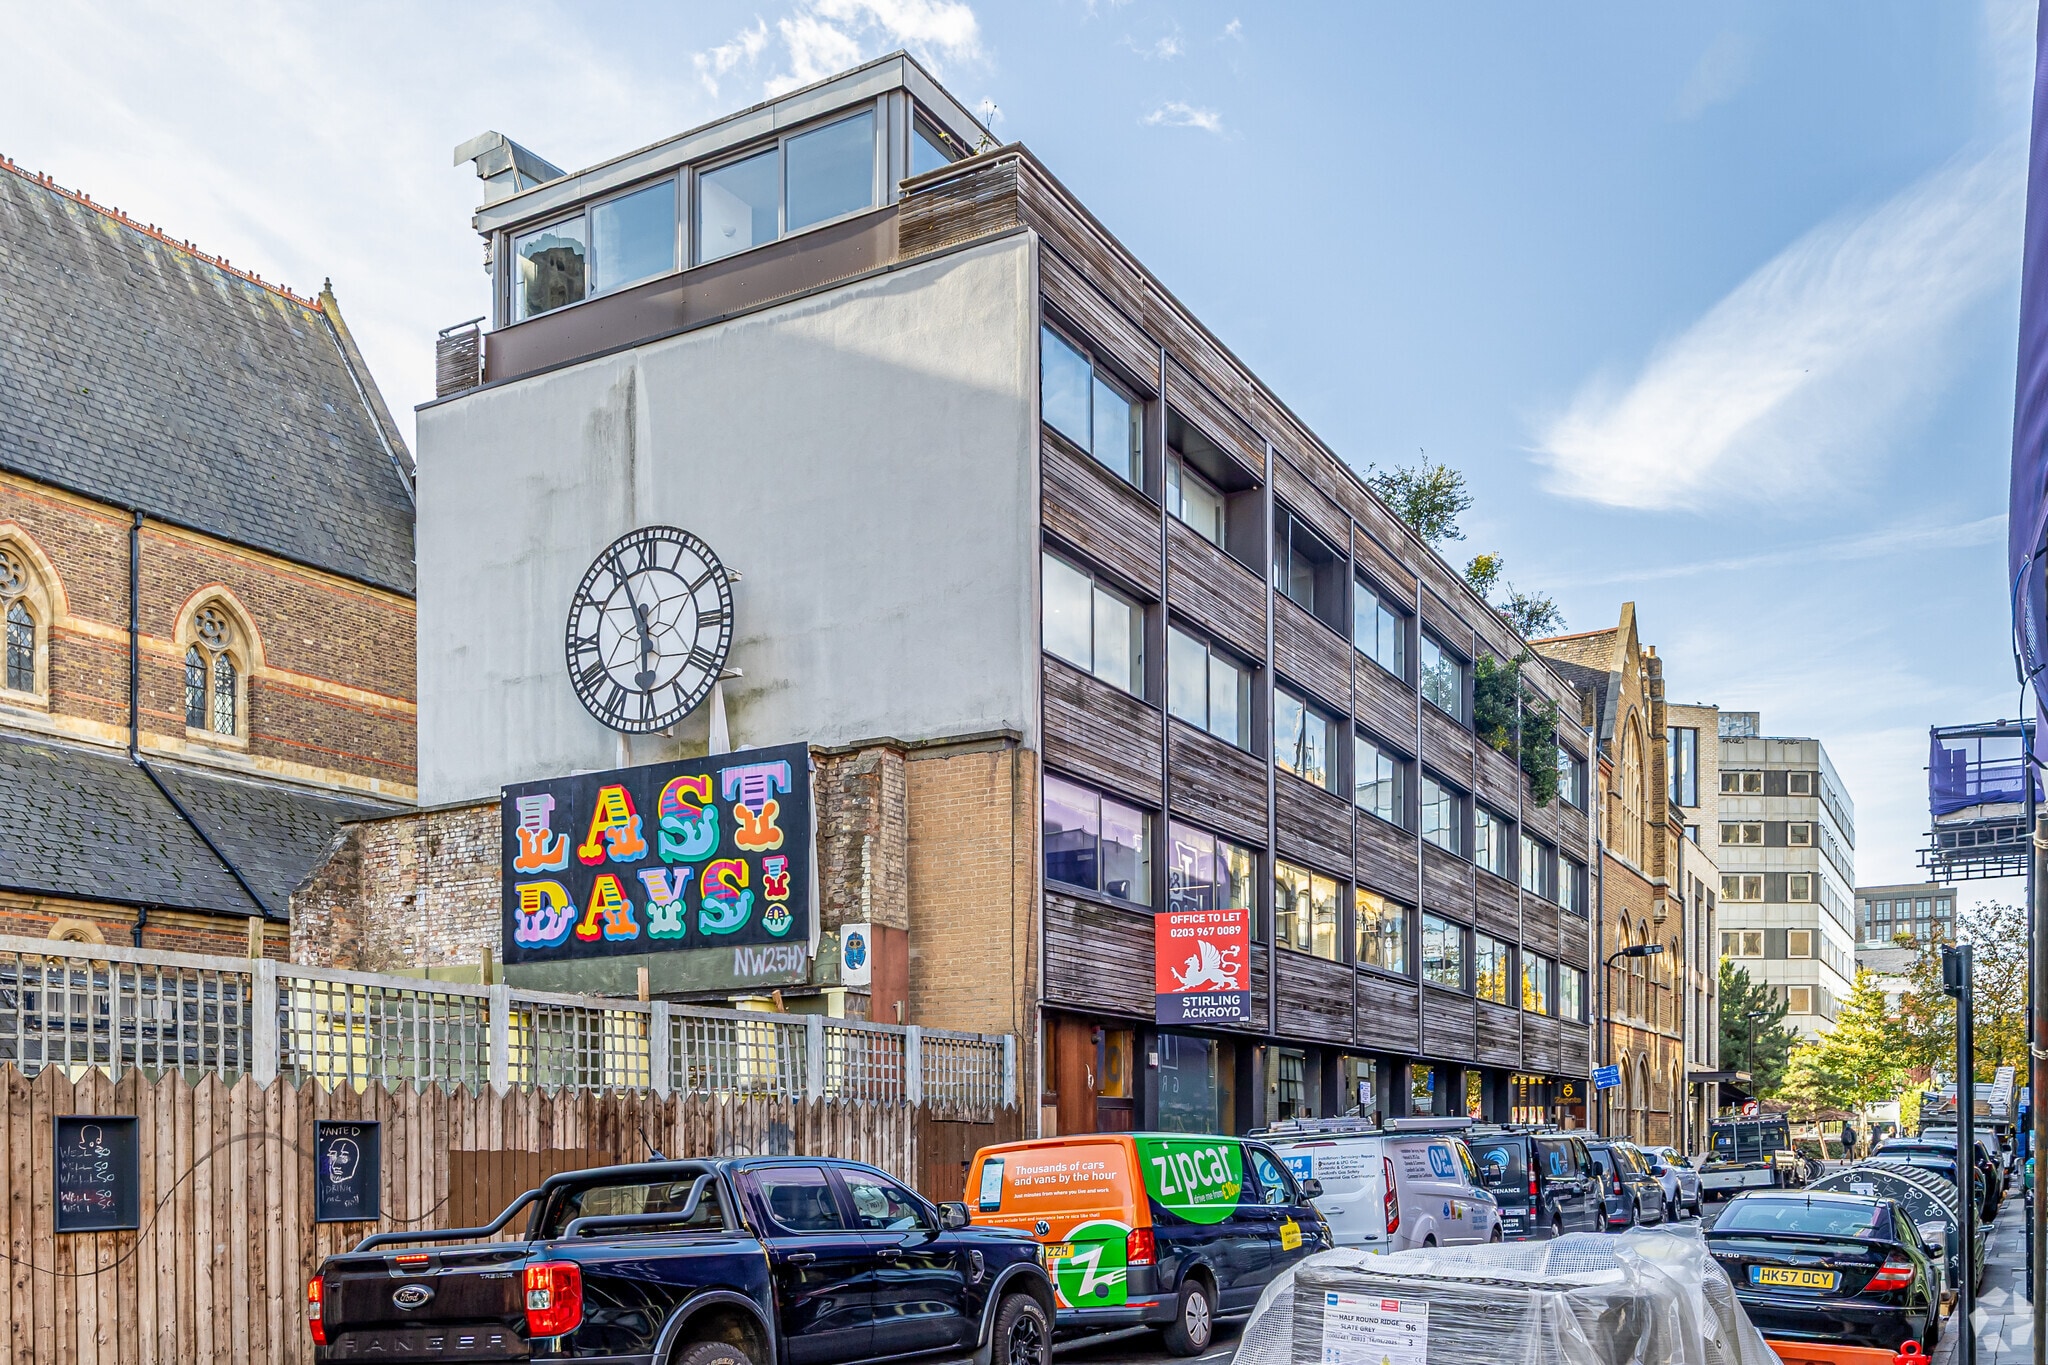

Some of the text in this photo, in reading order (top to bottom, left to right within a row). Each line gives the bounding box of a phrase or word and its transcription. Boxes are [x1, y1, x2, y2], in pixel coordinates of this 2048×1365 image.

[514, 759, 792, 874] LAST
[514, 854, 793, 949] DAYS!
[1170, 912, 1241, 924] OFFICE TO LET
[1170, 925, 1241, 938] 0203 967 0089
[1182, 995, 1240, 1007] STIRLING
[1182, 1006, 1240, 1018] ACKROYD
[1015, 1161, 1105, 1175] Thousands of cars
[1152, 1141, 1232, 1204] zipcar
[1014, 1171, 1117, 1186] and vans by the hour
[1762, 1270, 1830, 1285] HK57 OCY
[399, 1290, 420, 1302] Ford
[1356, 1316, 1378, 1324] ROUND
[1380, 1318, 1399, 1326] RIDGE
